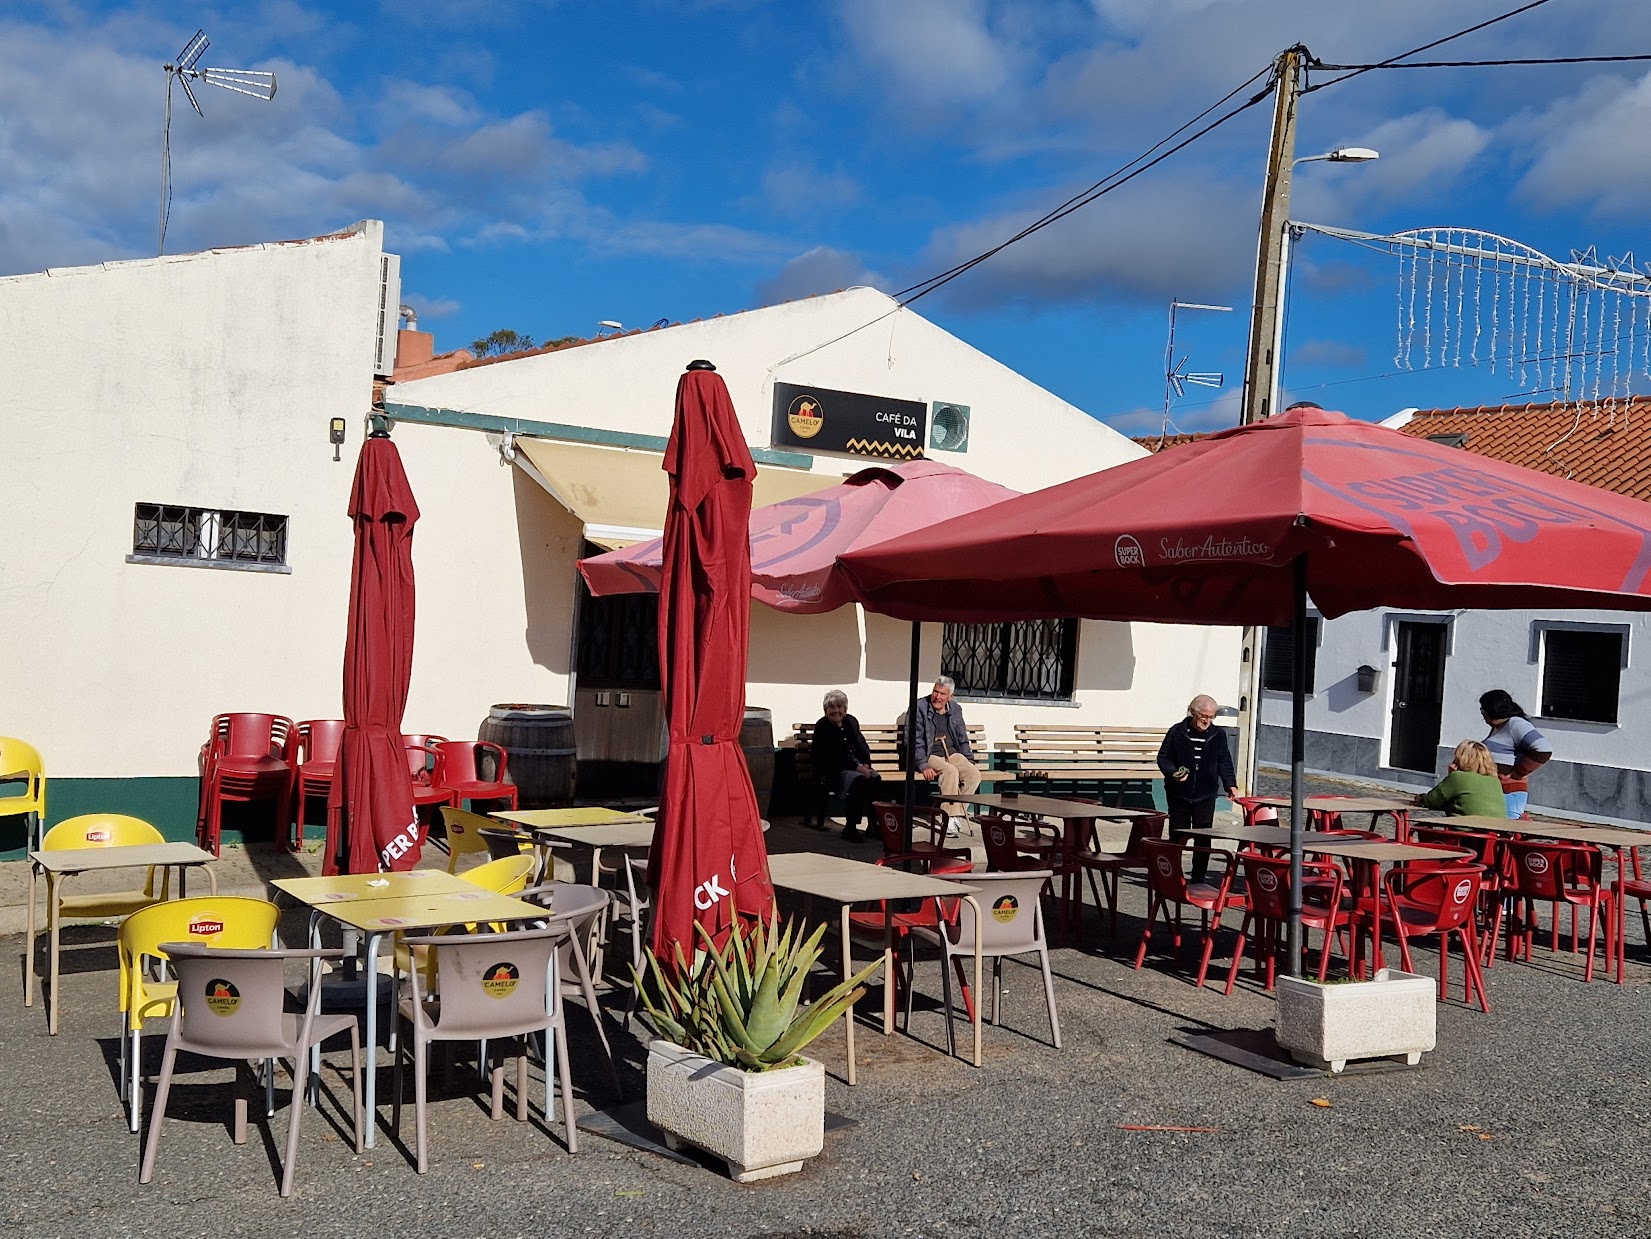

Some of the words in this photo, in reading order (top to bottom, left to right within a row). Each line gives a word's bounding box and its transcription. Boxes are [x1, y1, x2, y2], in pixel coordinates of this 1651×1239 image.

[790, 416, 820, 427] CAMELO
[875, 412, 901, 425] CAFÉ
[903, 415, 918, 427] DA
[893, 427, 917, 440] VILA
[1346, 465, 1514, 511] SUPER
[1428, 495, 1597, 572] BOCK
[1117, 545, 1140, 557] SUPER
[1158, 537, 1200, 560] Sabor
[1198, 534, 1274, 561] Autêntico
[1119, 554, 1141, 565] BOCK
[191, 923, 221, 934] Lipton
[484, 980, 517, 988] CAMELO
[207, 997, 238, 1006] CAMELO
